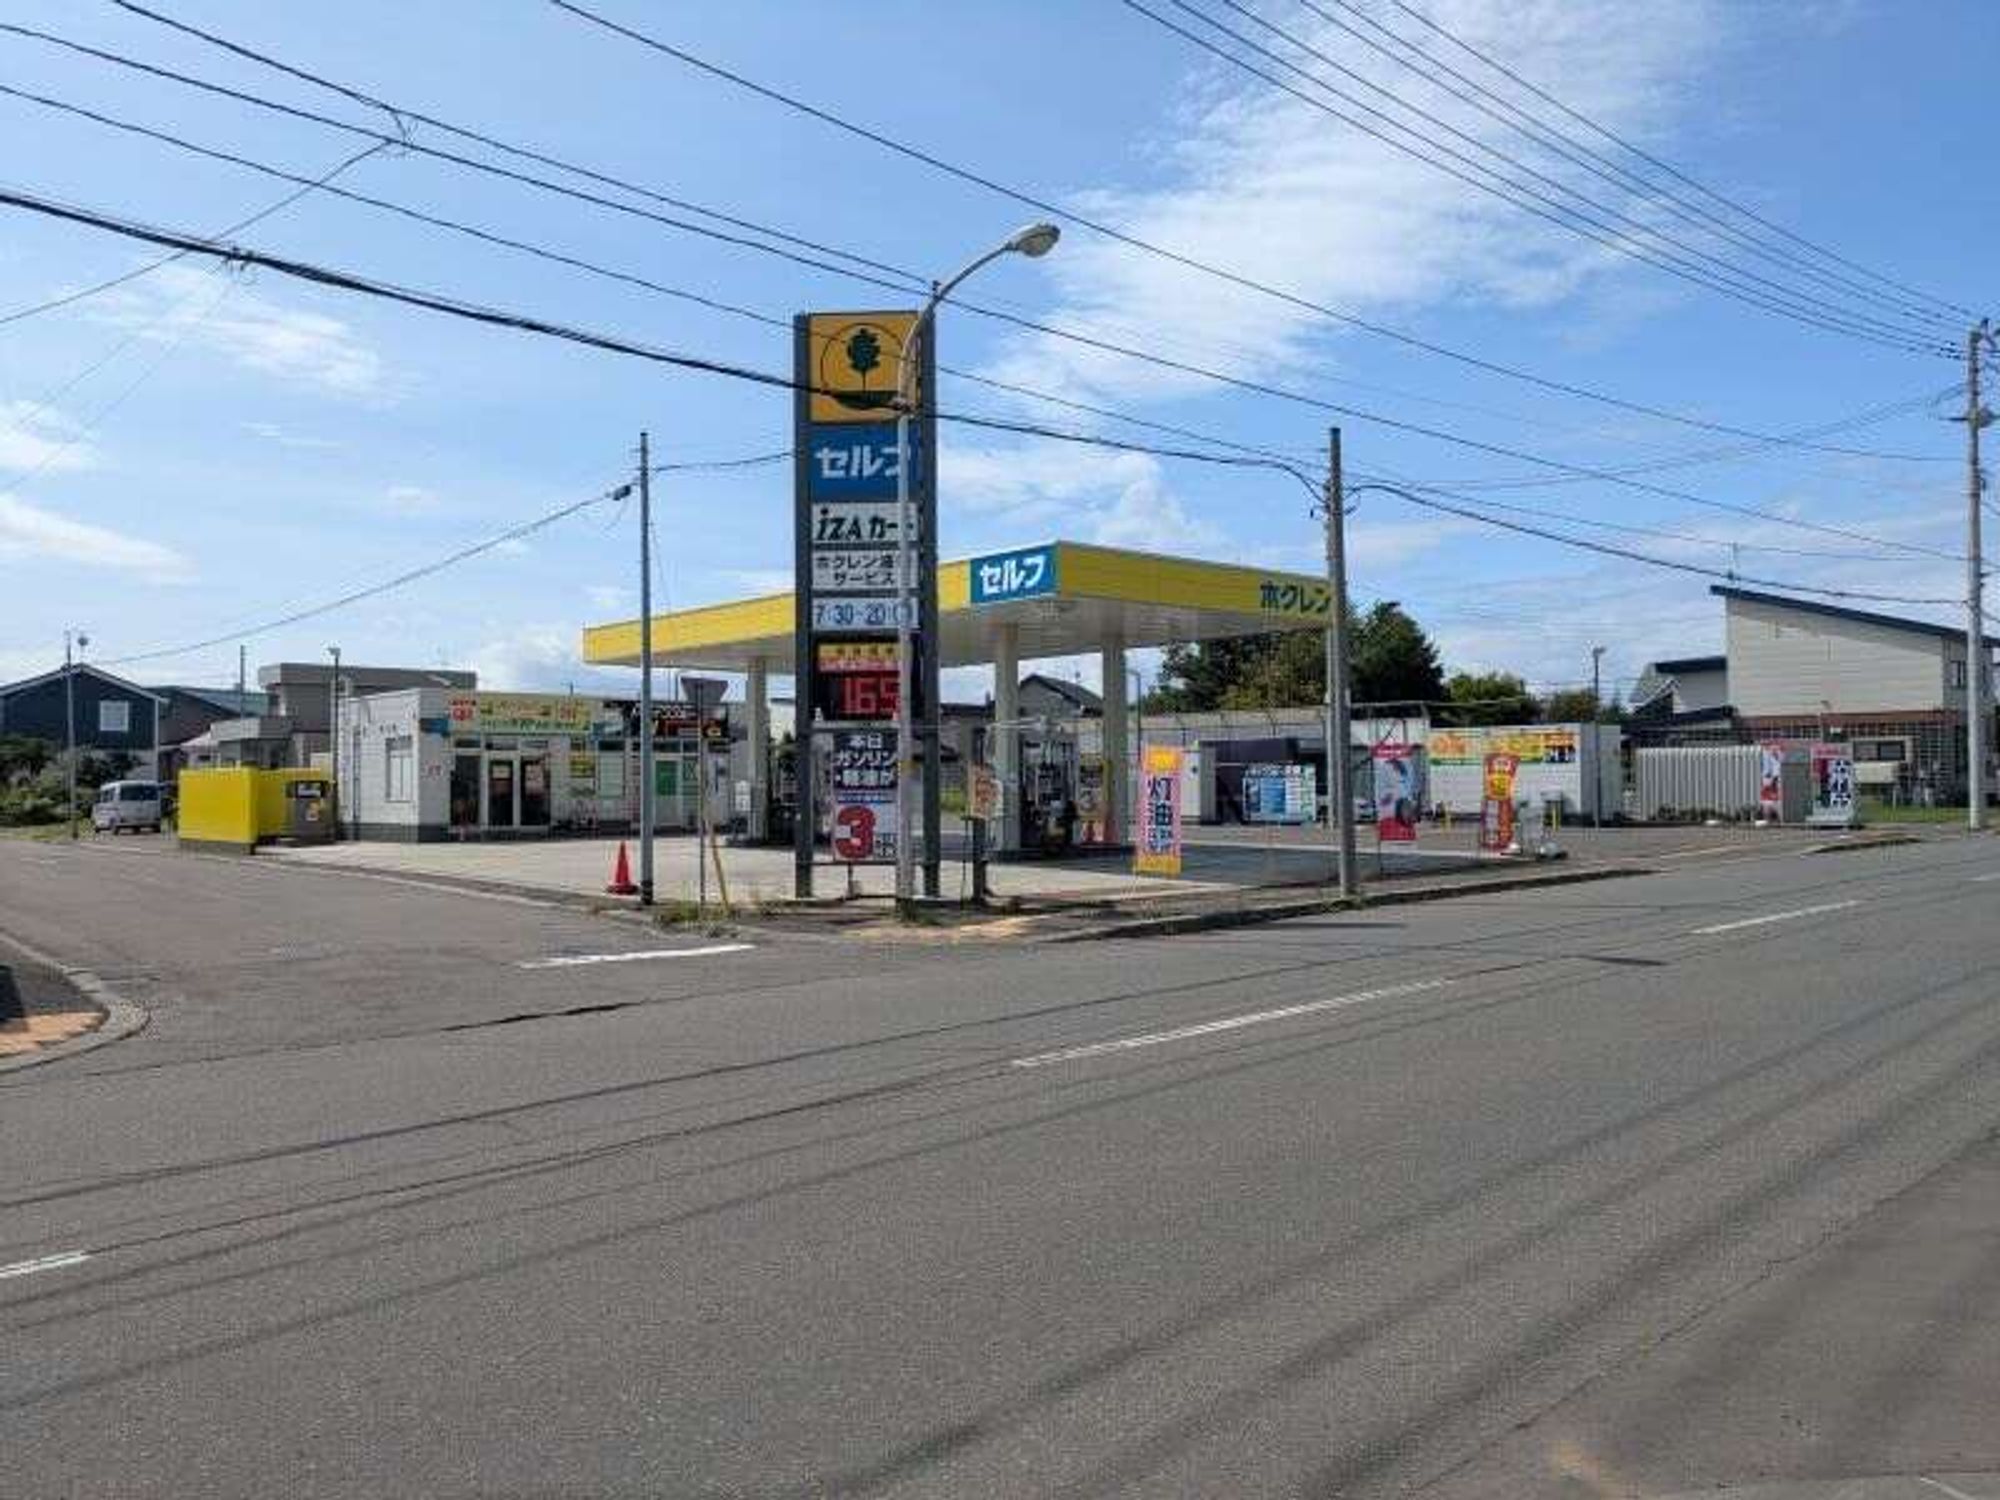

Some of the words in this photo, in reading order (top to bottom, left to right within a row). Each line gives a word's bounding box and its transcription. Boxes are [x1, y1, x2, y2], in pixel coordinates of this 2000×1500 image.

[980, 555, 1046, 596] セルフ
[1260, 580, 1331, 614] ホクレン
[835, 805, 876, 859] 3
